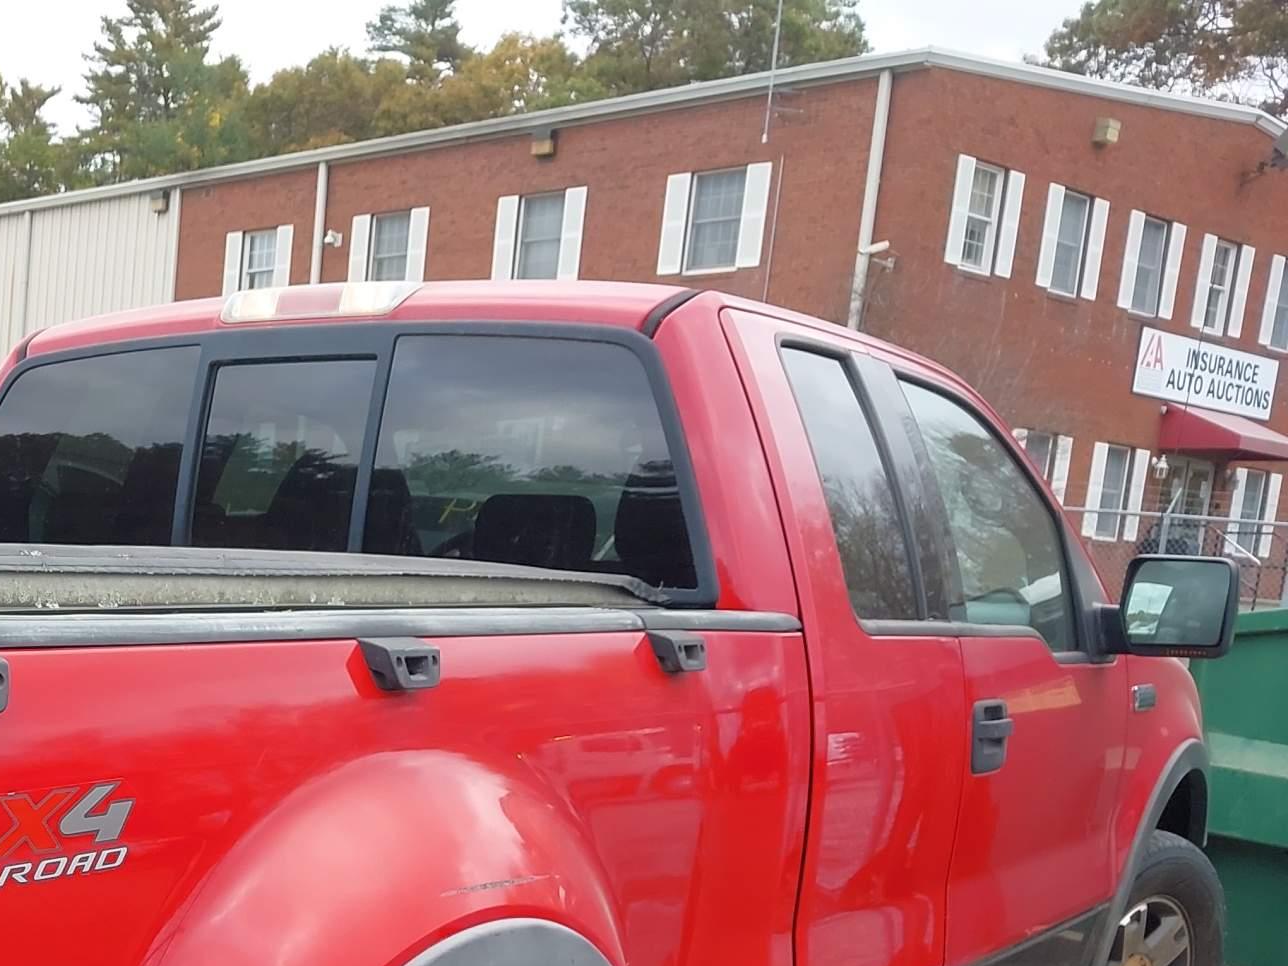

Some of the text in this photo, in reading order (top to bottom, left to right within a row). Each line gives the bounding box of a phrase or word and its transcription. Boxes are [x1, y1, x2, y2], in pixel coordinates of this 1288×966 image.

[1185, 347, 1261, 384] INSURANCE
[1165, 369, 1271, 410] AUTO AUCTIONS
